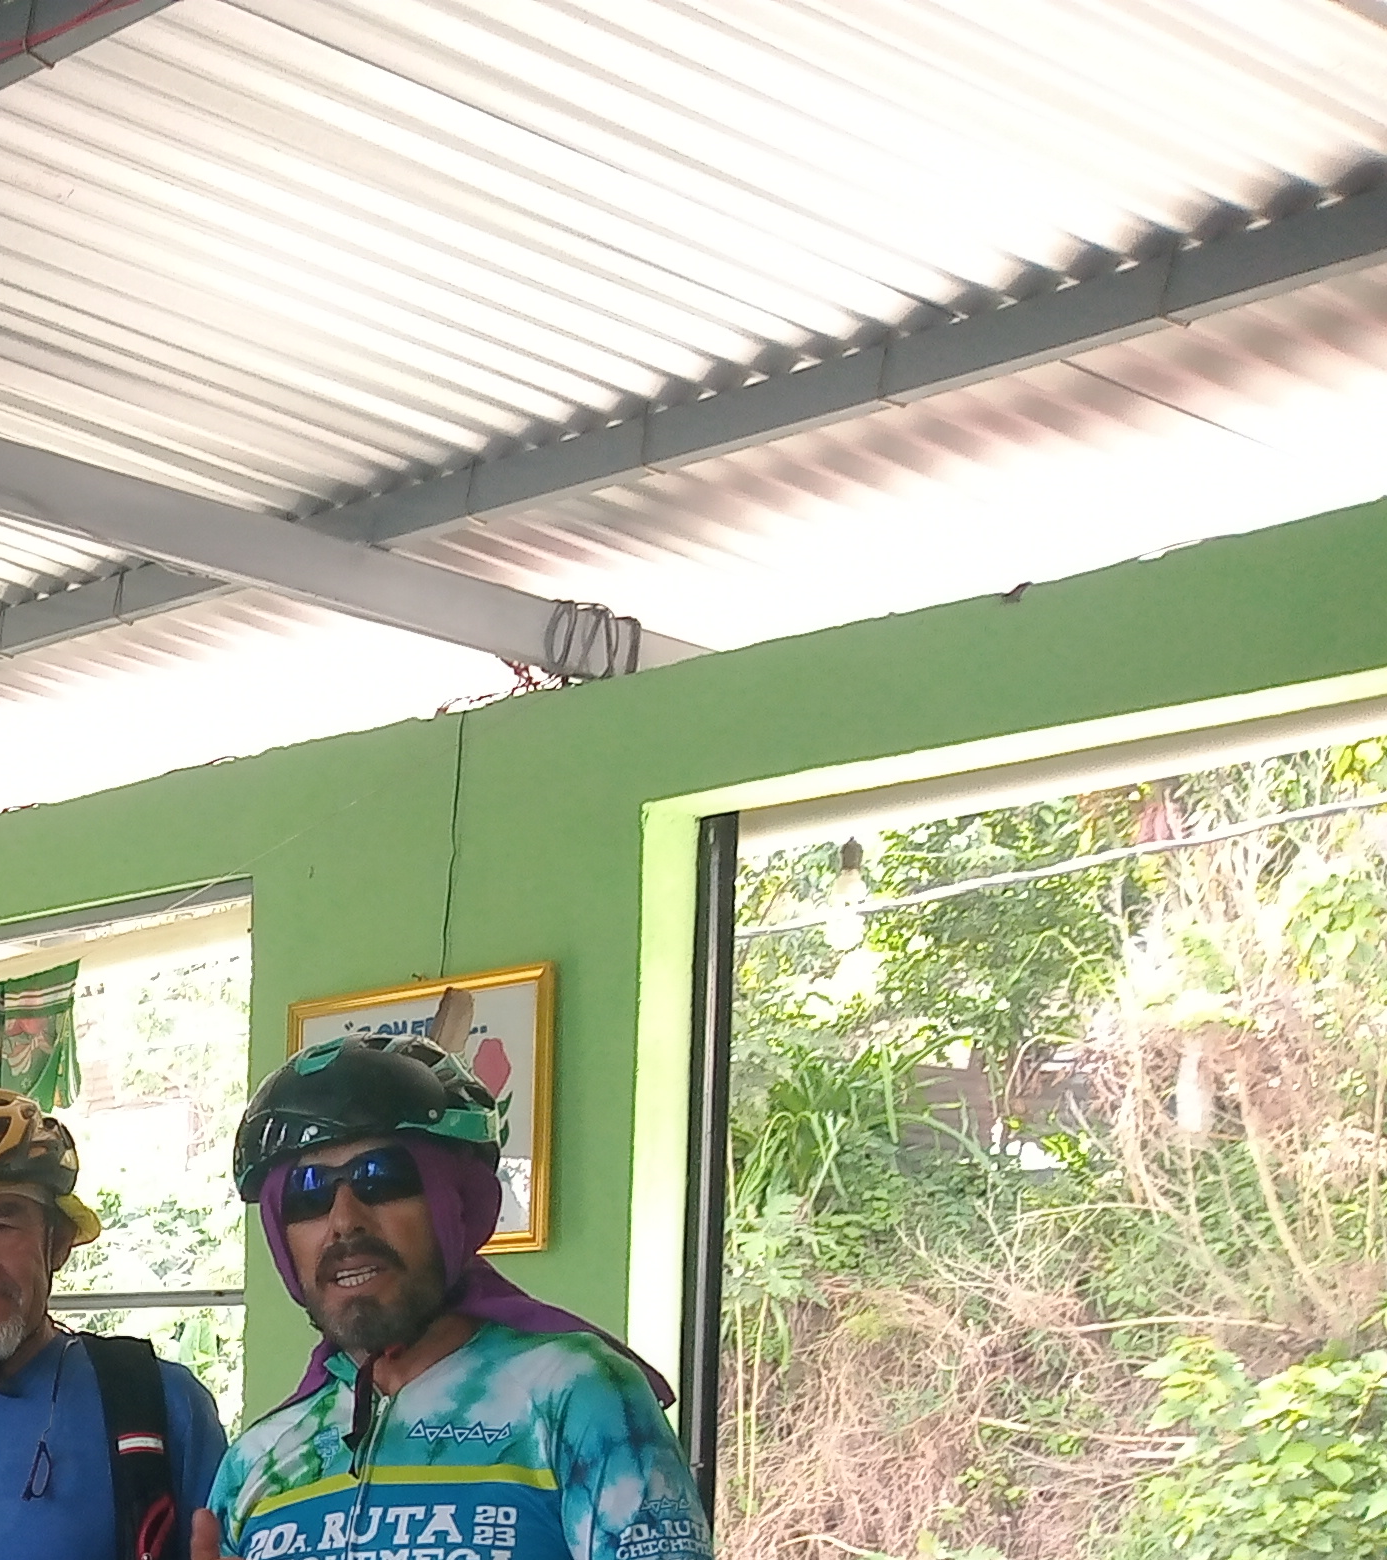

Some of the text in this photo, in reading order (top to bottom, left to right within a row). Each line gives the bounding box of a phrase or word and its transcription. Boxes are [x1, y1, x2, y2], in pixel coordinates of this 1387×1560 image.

[316, 1503, 464, 1551] RUTA
[472, 1505, 518, 1526] 20
[471, 1525, 517, 1548] 23
